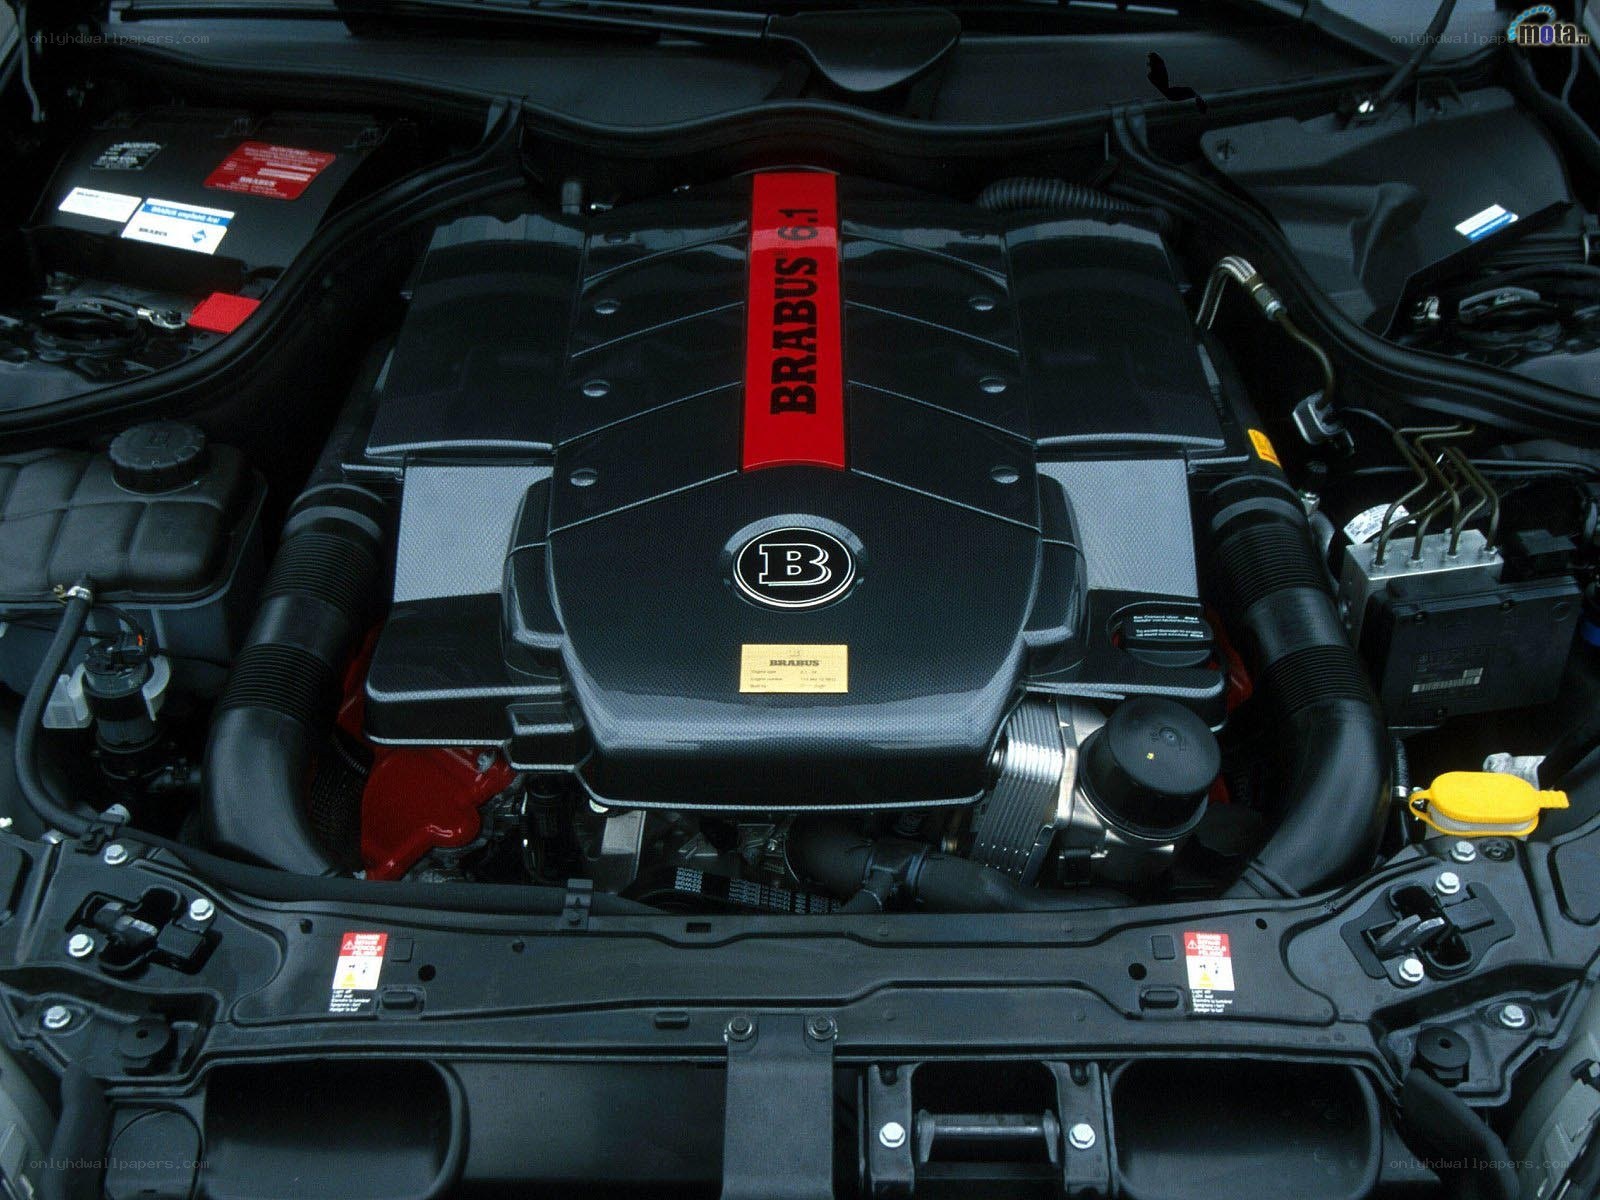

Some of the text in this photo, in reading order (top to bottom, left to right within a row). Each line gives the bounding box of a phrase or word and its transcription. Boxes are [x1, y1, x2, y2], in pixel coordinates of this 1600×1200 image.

[770, 208, 819, 415] BRABUS 6.1
[758, 542, 832, 587] B
[769, 659, 820, 667] BRABUS
